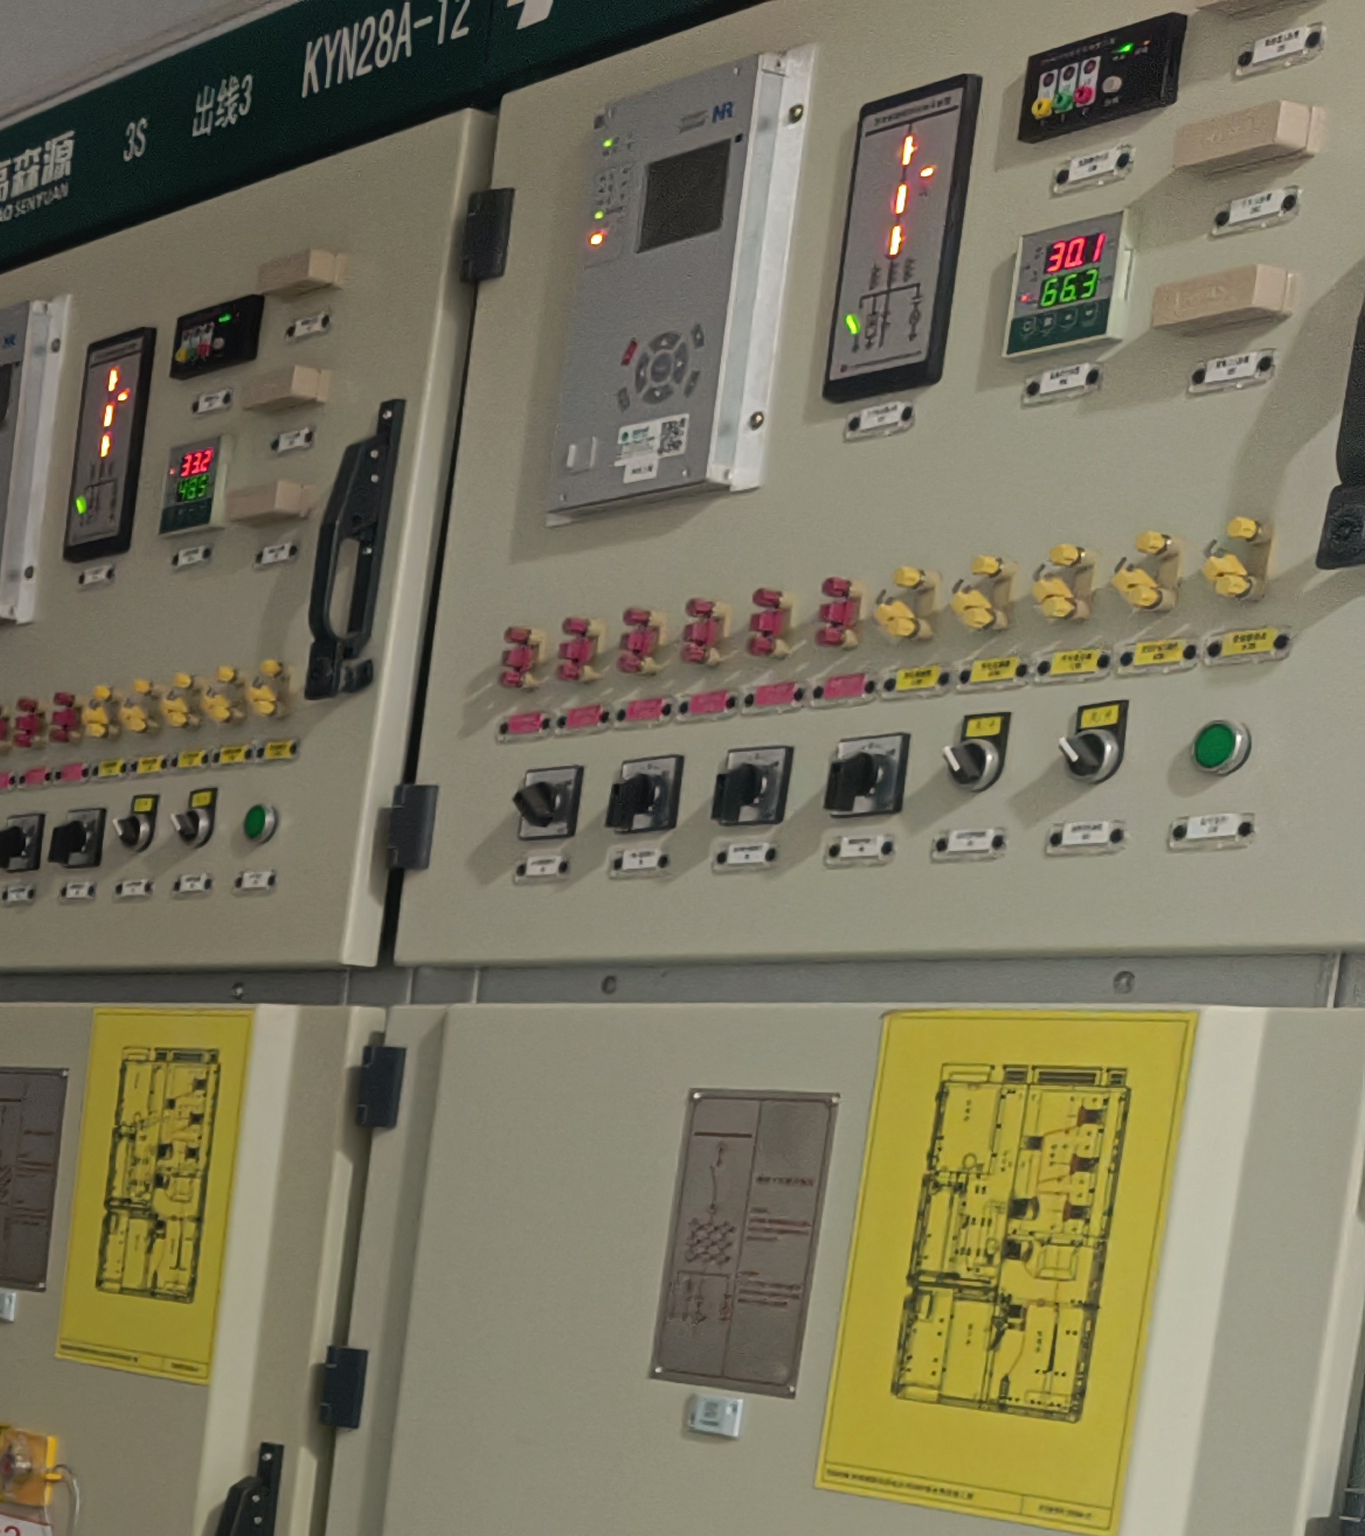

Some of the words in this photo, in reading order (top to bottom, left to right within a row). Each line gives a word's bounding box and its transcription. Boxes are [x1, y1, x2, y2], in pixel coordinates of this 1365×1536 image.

[302, 0, 469, 98] KYN28A-12
[124, 117, 148, 162] 3S
[193, 74, 254, 137] 出线3
[712, 102, 735, 123] NR
